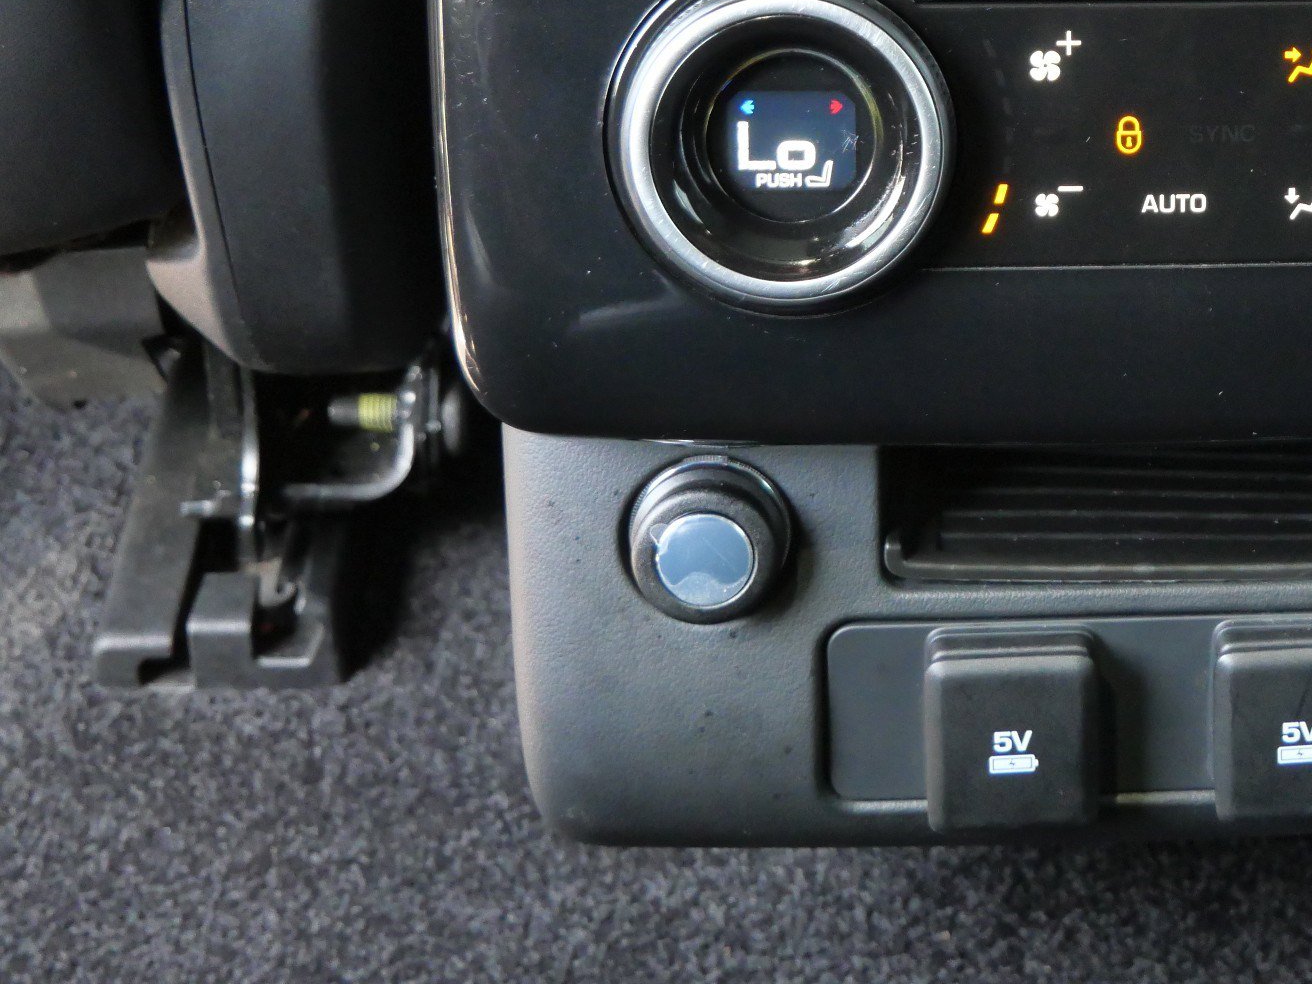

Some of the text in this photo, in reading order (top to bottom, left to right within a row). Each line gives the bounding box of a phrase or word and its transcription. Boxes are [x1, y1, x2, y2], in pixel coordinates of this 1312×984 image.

[1190, 124, 1256, 143] SYNC
[737, 121, 816, 170] Lo
[755, 173, 803, 188] PUSH
[1141, 193, 1207, 213] AUTO
[993, 729, 1033, 753] 5V
